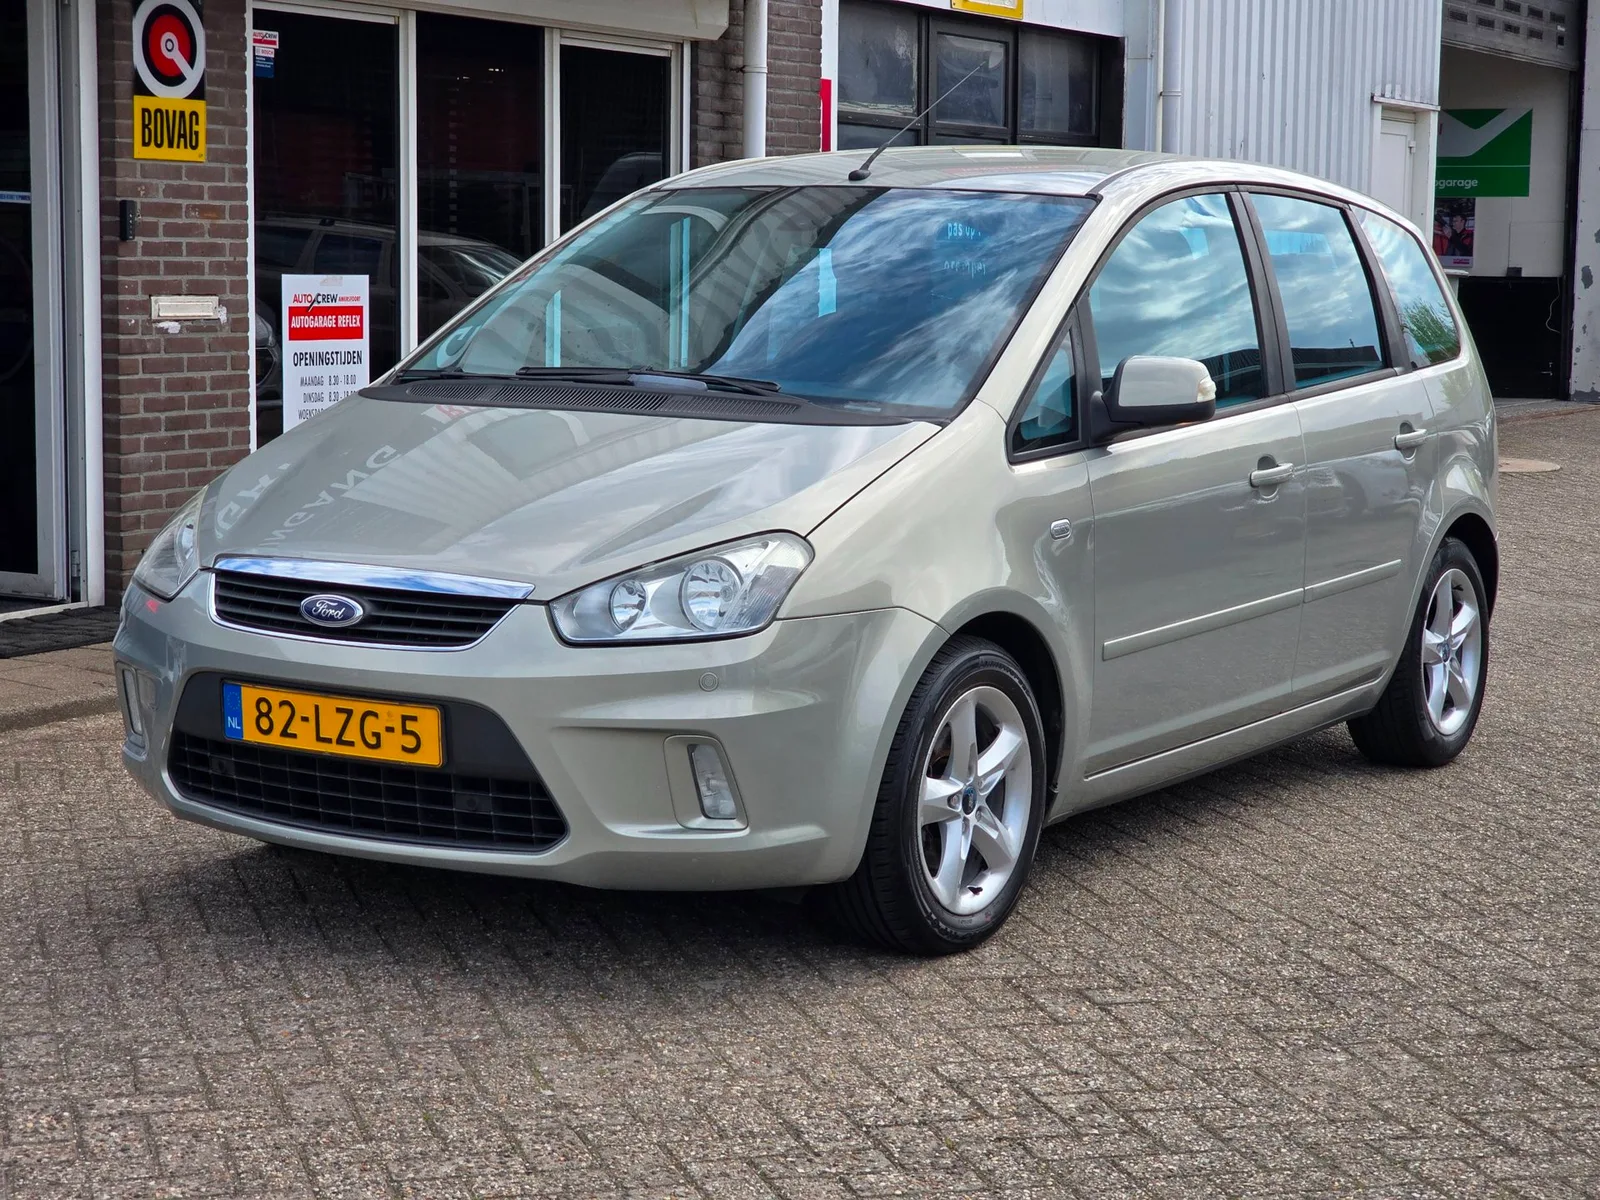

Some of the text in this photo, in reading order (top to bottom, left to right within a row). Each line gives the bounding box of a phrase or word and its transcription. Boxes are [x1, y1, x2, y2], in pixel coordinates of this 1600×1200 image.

[141, 107, 199, 150] BOVAG
[291, 315, 361, 328] AUTOGARAGE REFLEX
[293, 350, 362, 367] OPENINGSTIJDEN
[300, 375, 324, 387] MAANDAG
[328, 375, 339, 386] 8.30
[343, 374, 356, 385] 18.00
[303, 392, 324, 403] DINSDAG
[328, 391, 339, 402] 8.30
[298, 408, 324, 420] WOENSD
[311, 600, 345, 620] Ford
[227, 716, 241, 730] NL
[255, 697, 421, 754] 82-LZG-5
